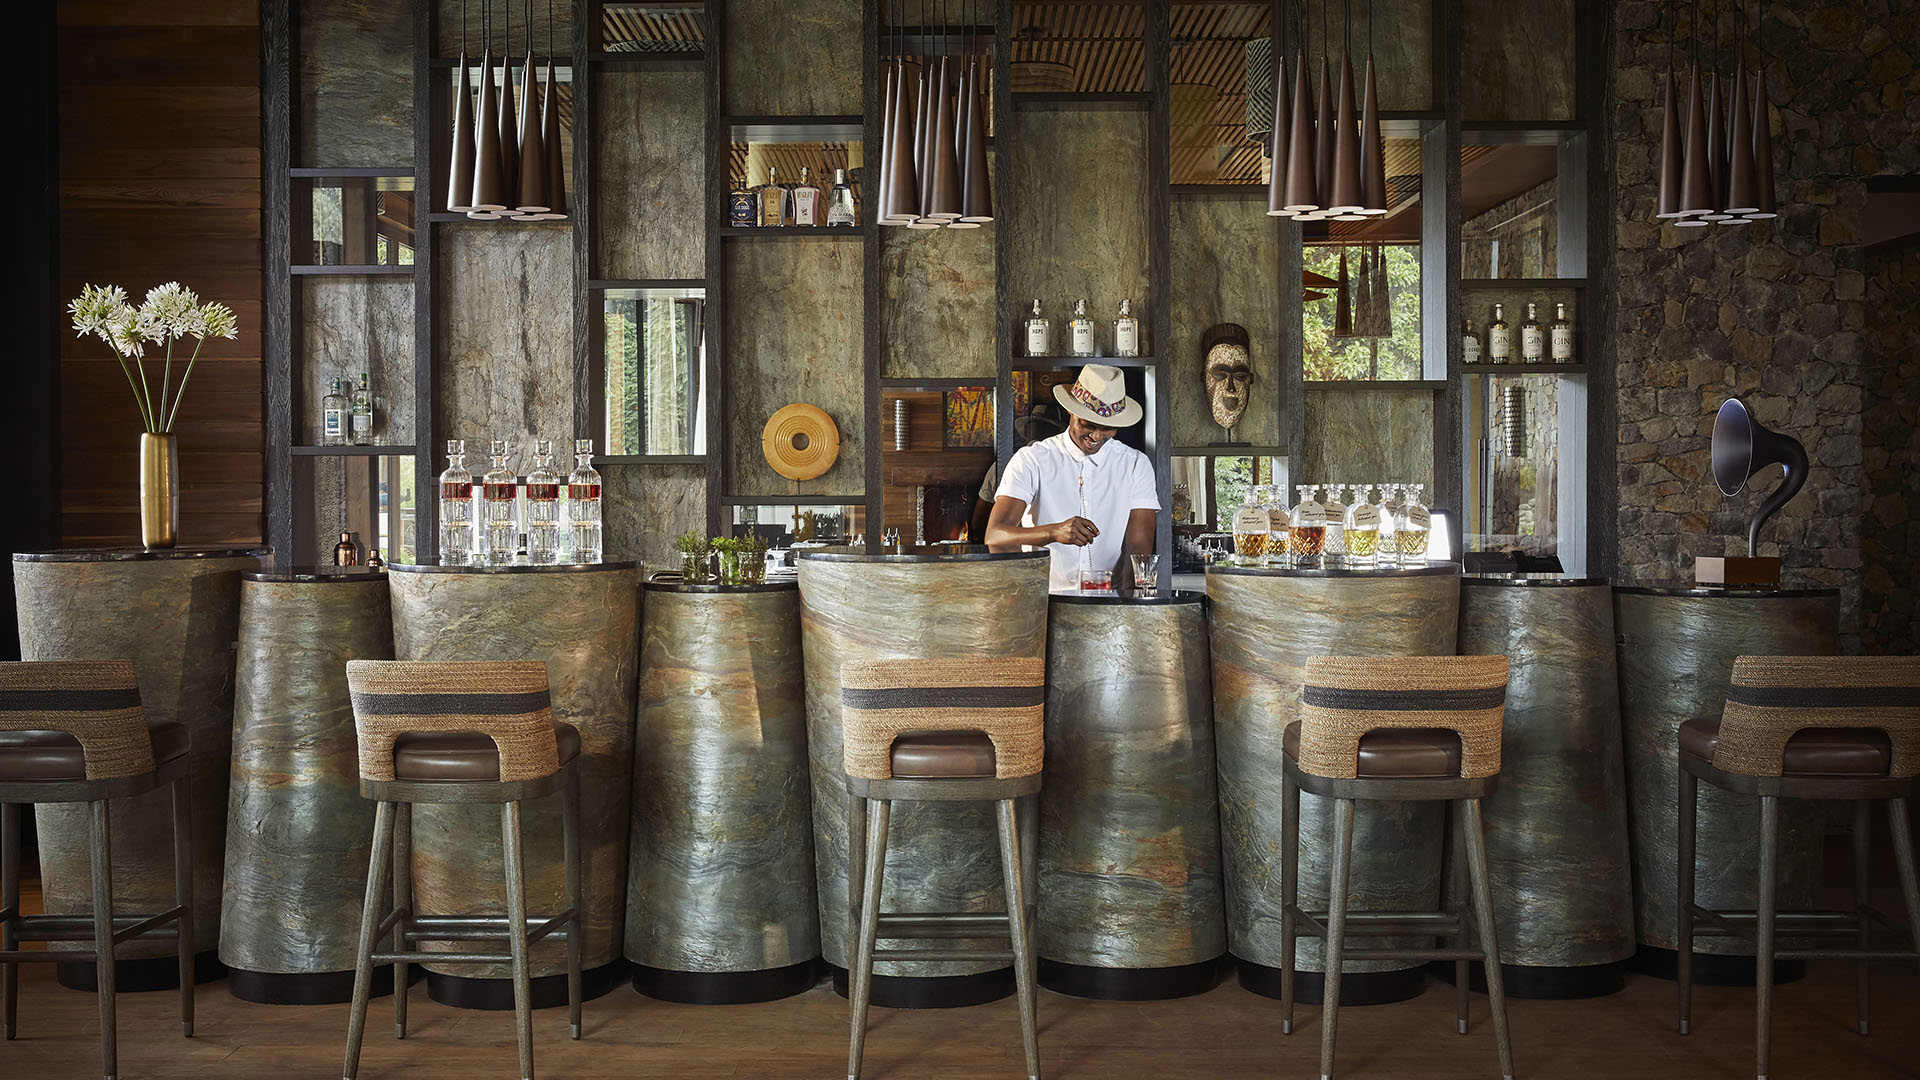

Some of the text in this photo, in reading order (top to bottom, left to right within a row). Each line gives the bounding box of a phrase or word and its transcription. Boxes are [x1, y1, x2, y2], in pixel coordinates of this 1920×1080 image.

[1494, 336, 1509, 344] GIN
[1527, 336, 1542, 344] GIN
[1553, 337, 1570, 345] GIN
